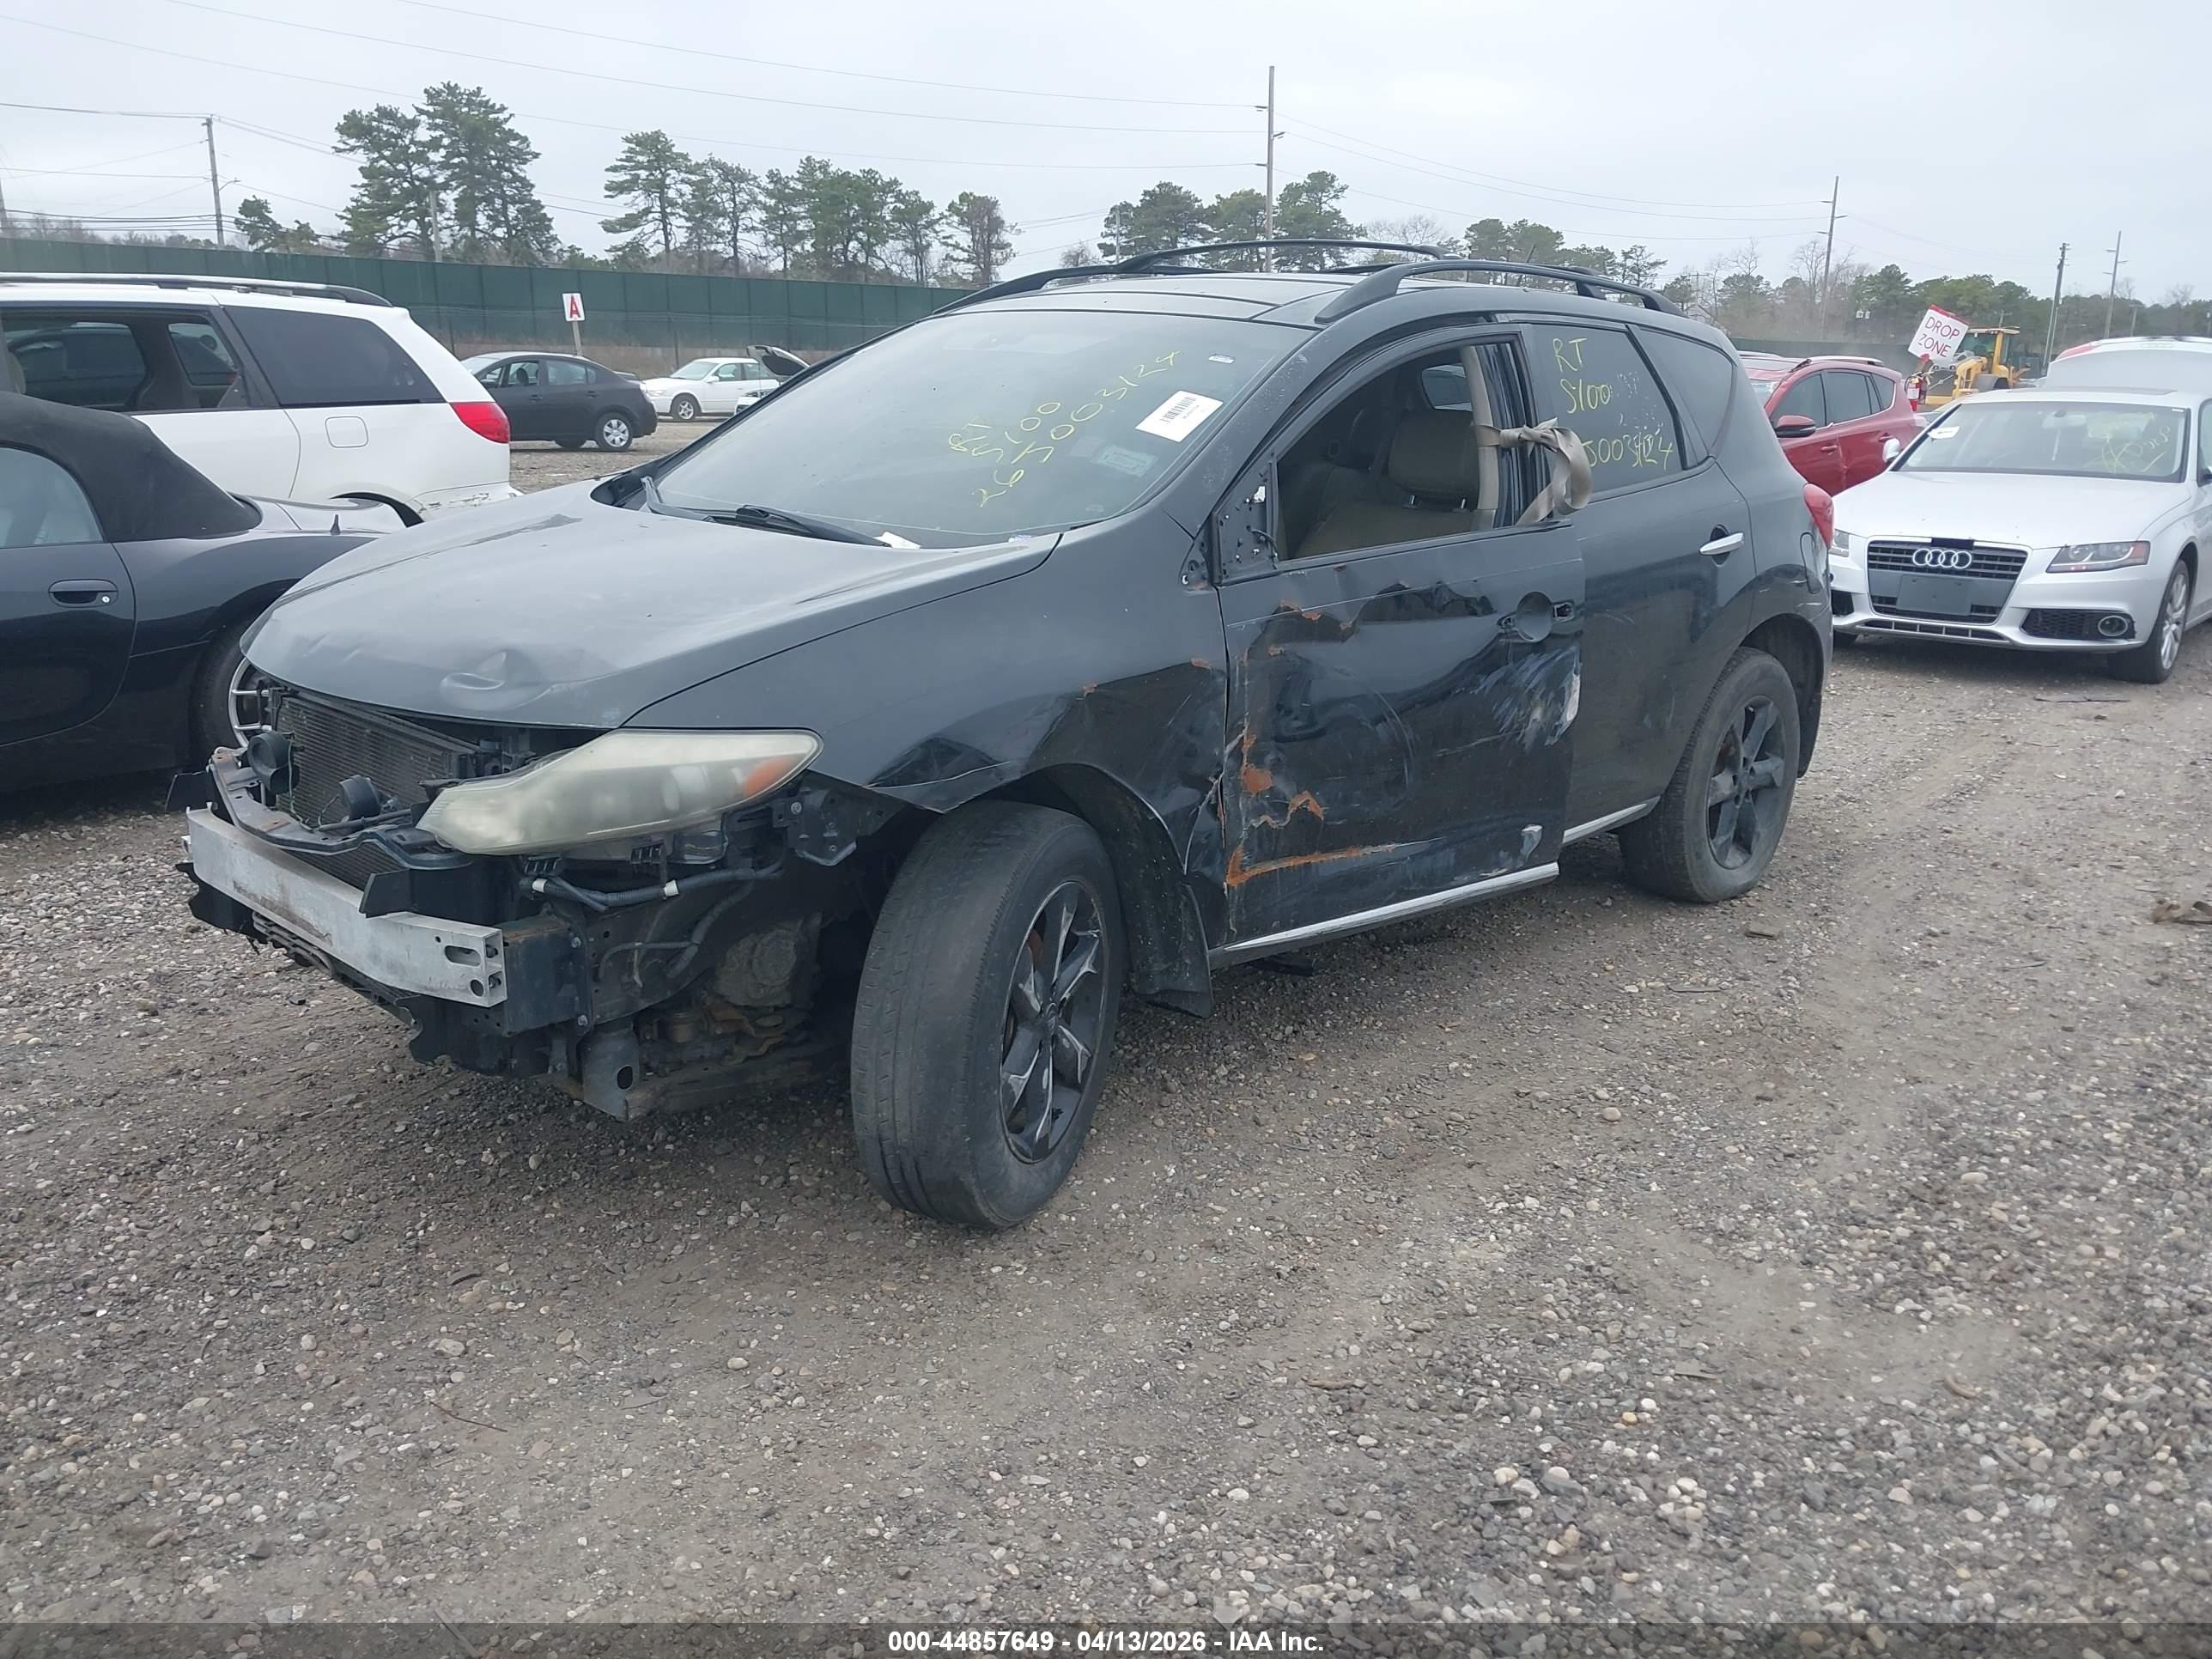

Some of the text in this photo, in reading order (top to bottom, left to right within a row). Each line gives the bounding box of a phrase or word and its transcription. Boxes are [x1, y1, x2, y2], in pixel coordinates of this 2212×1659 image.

[569, 295, 581, 318] A
[1924, 316, 1960, 340] DROP
[1553, 337, 1587, 373] RT
[1917, 333, 1952, 357] ZONE
